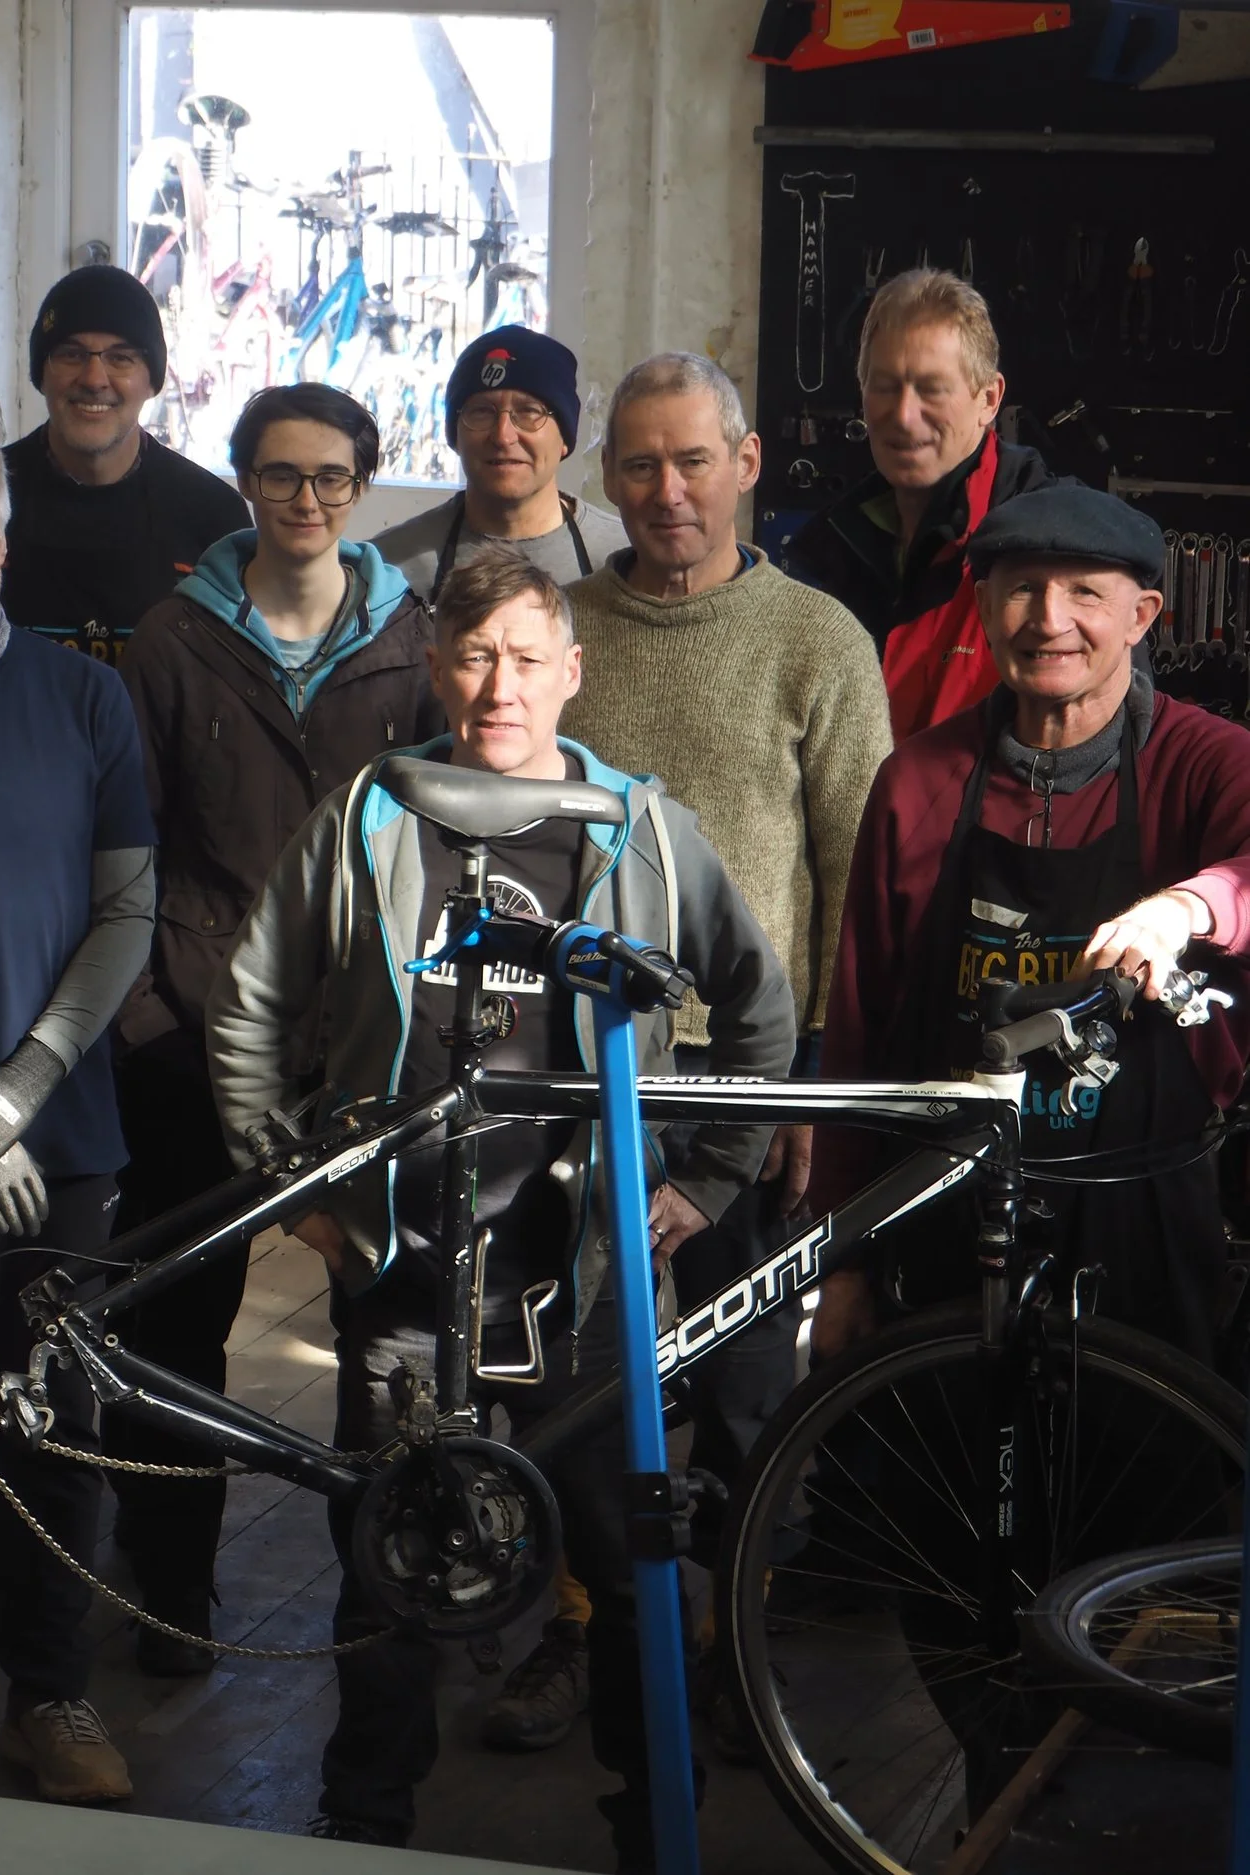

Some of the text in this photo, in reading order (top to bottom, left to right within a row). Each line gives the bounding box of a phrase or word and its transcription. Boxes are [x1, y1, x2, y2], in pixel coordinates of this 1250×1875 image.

[804, 221, 820, 308] HAMMER
[483, 363, 504, 387] hp
[83, 619, 110, 638] The
[1014, 931, 1041, 950] The
[1017, 950, 1086, 987] BIK
[635, 1076, 780, 1085] PORTSTER
[1021, 1080, 1103, 1120] ling
[1049, 1114, 1077, 1130] UK
[330, 1144, 378, 1180] SCOTT
[655, 1222, 825, 1377] SCOTT
